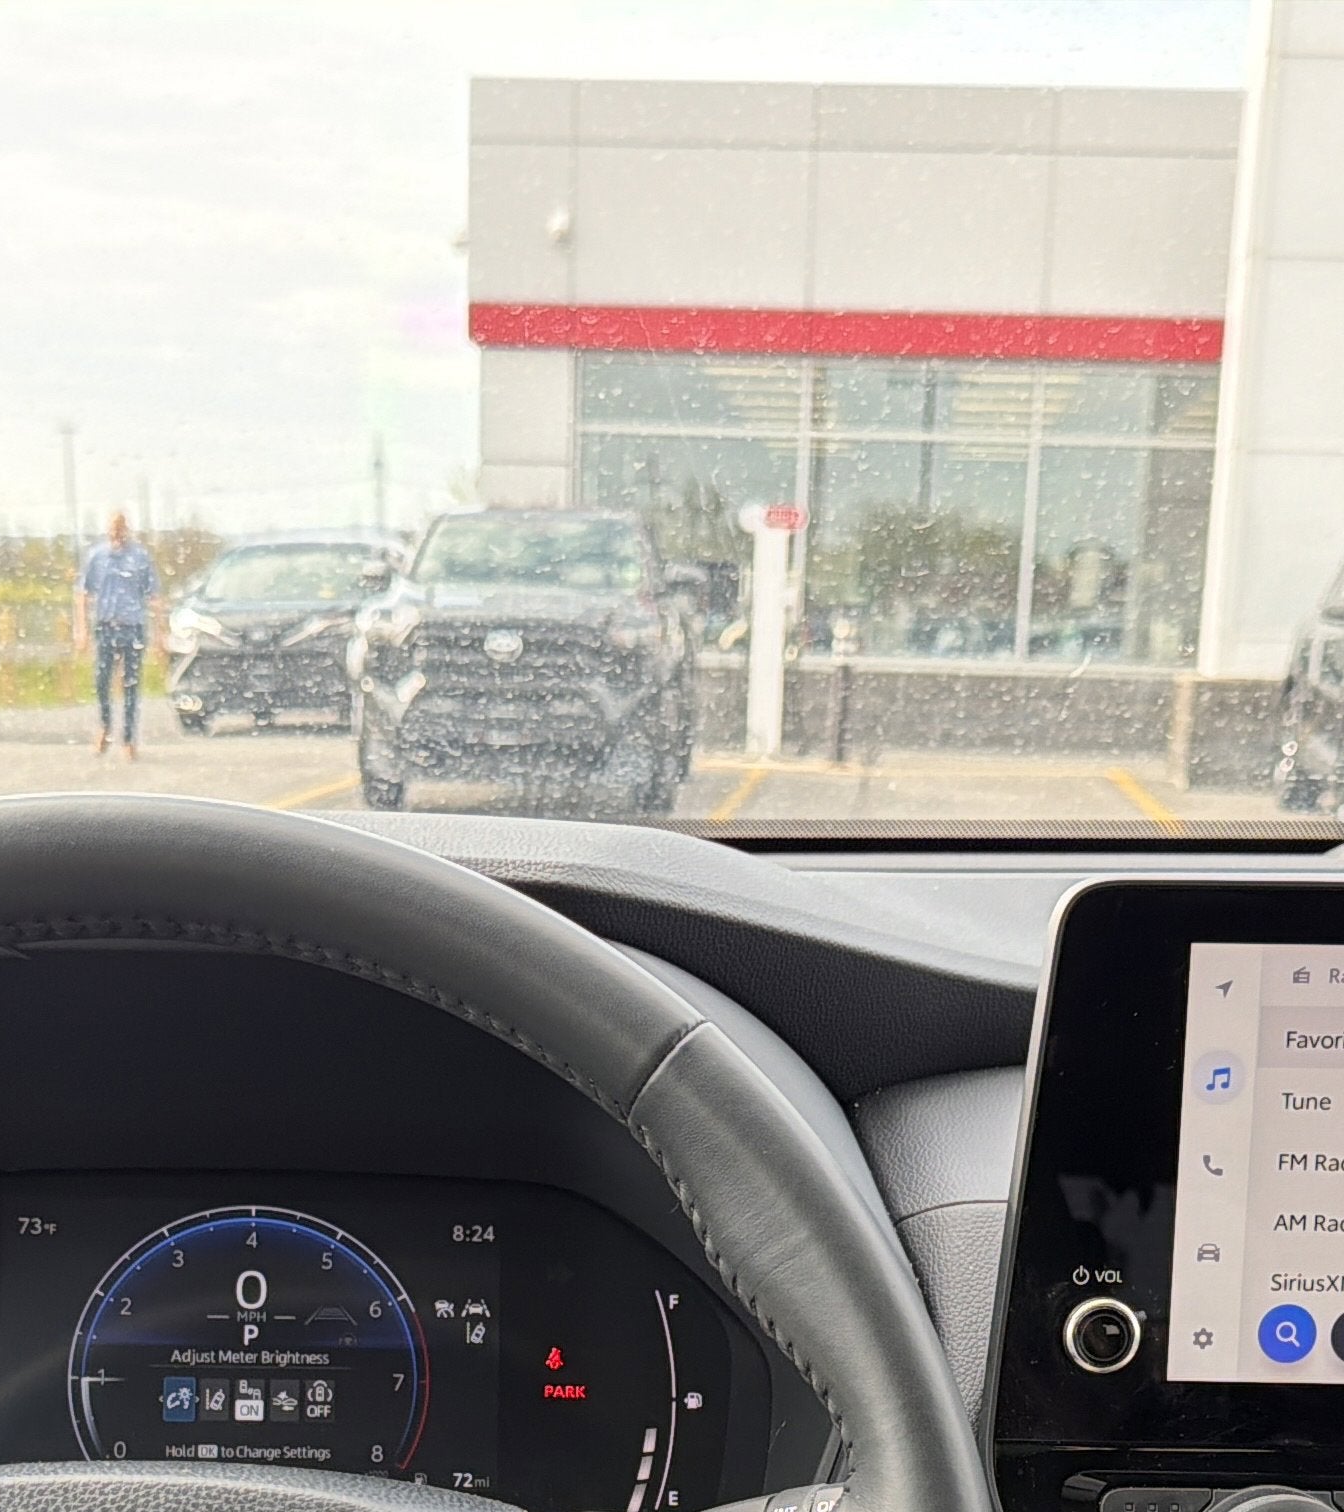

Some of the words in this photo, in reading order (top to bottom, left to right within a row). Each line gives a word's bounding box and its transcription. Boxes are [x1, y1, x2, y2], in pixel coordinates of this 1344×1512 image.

[1282, 1093, 1332, 1112] Tune
[1278, 1154, 1308, 1172] FM
[1273, 1215, 1307, 1232] AM
[245, 1231, 258, 1249] 4
[452, 1224, 496, 1243] 8:24
[172, 1250, 185, 1268] 3
[321, 1252, 333, 1270] 5
[1094, 1269, 1123, 1284] VOL
[235, 1270, 267, 1310] 0
[120, 1298, 133, 1316] 2
[368, 1301, 382, 1319] 6
[669, 1295, 679, 1310] F
[237, 1311, 267, 1323] MPH
[243, 1324, 259, 1346] P
[170, 1349, 216, 1367] Adjust
[219, 1350, 257, 1364] Meter
[261, 1351, 330, 1367] Brightness
[392, 1373, 405, 1391] 7
[544, 1384, 586, 1399] PARK
[240, 1404, 259, 1417] ON
[306, 1405, 332, 1419] OFF
[113, 1441, 126, 1459] 0
[166, 1444, 195, 1458] Hold
[200, 1446, 216, 1457] OK
[221, 1446, 234, 1459] to
[236, 1446, 282, 1461] Change
[284, 1446, 331, 1462] Settings
[370, 1444, 384, 1463] 8
[668, 1491, 679, 1507] E
